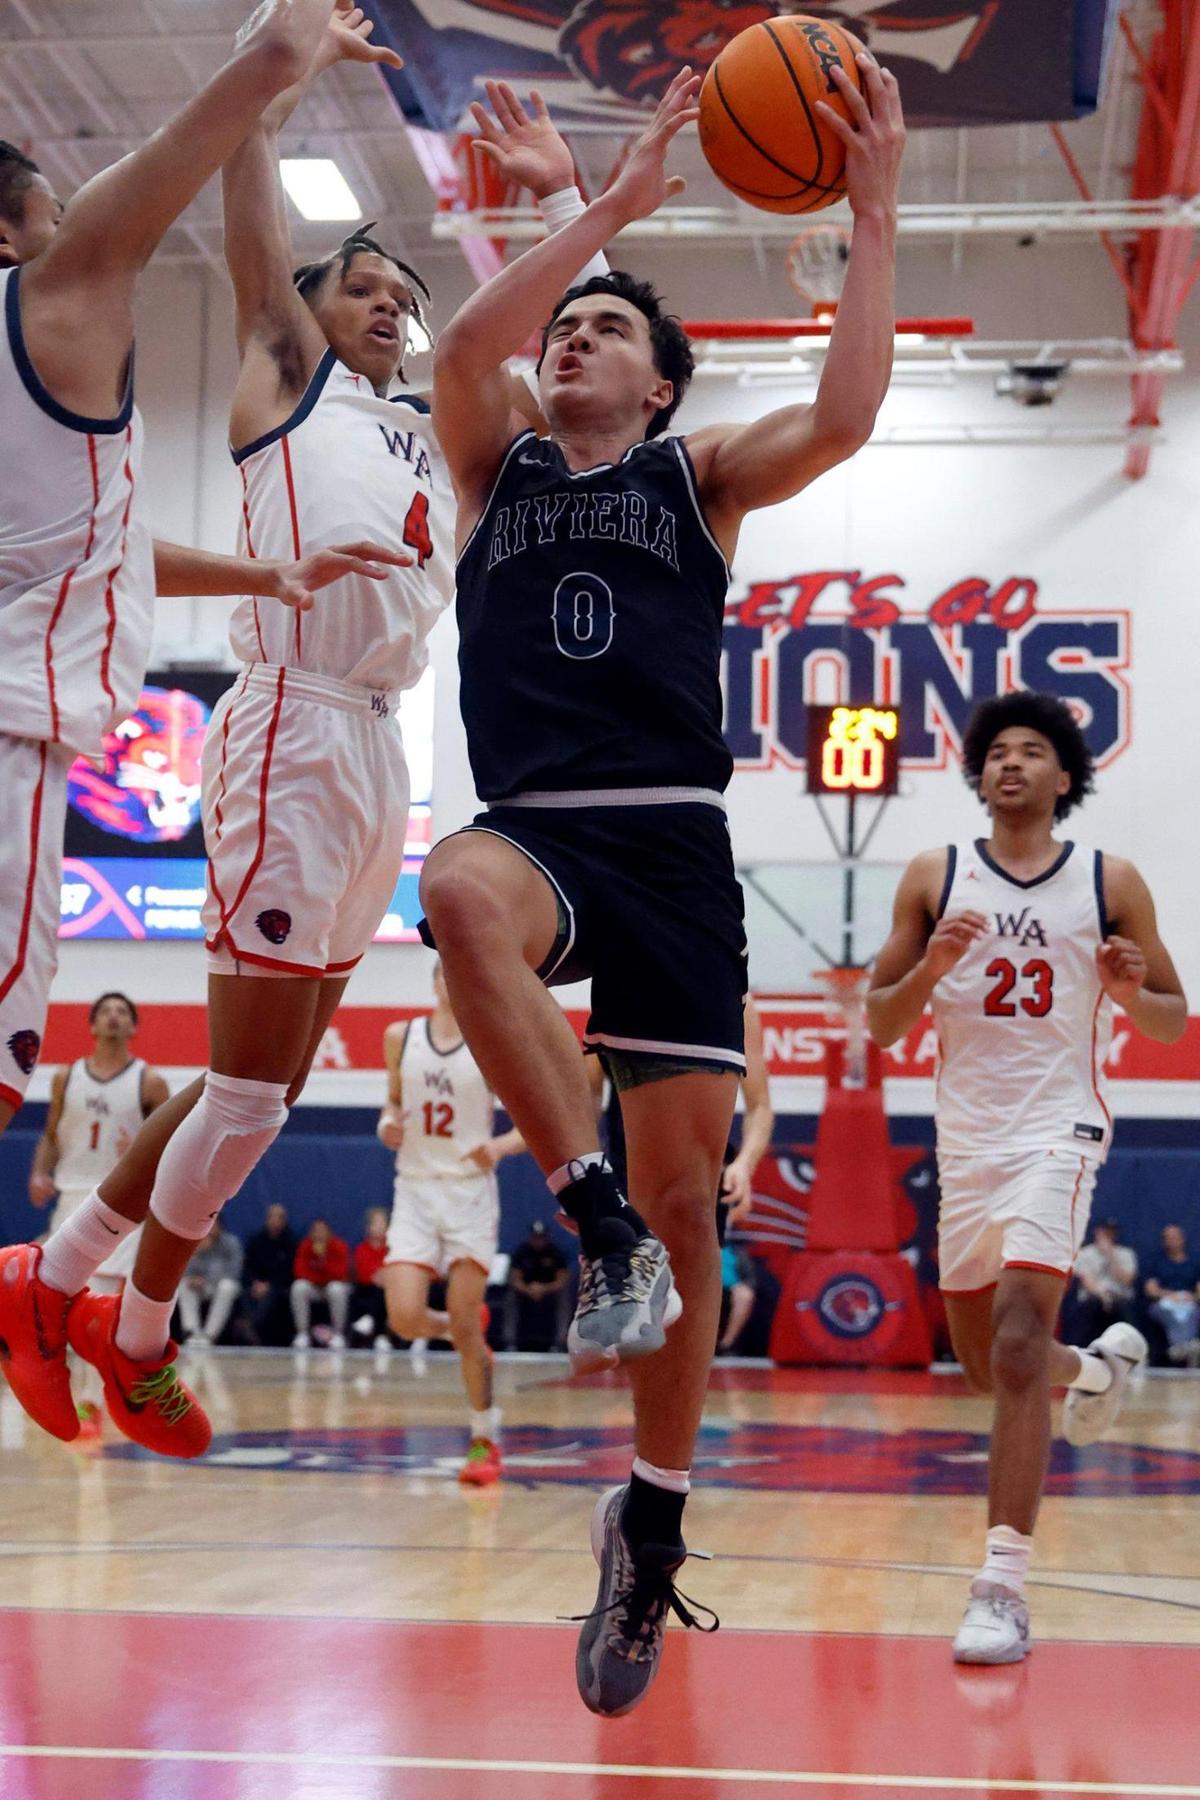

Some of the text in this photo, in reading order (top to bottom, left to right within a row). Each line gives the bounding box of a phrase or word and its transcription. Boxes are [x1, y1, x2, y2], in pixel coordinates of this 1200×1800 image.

[377, 423, 434, 491] WA
[402, 489, 434, 571] 4
[487, 490, 681, 573] RIVIERA
[549, 571, 618, 660] 0
[724, 569, 1039, 630] ET'S GO
[722, 611, 1130, 770] IONS
[822, 738, 884, 789] 00
[995, 907, 1048, 947] WA
[984, 957, 1054, 1018] 23
[89, 1120, 101, 1151] 1
[422, 1101, 455, 1138] 12
